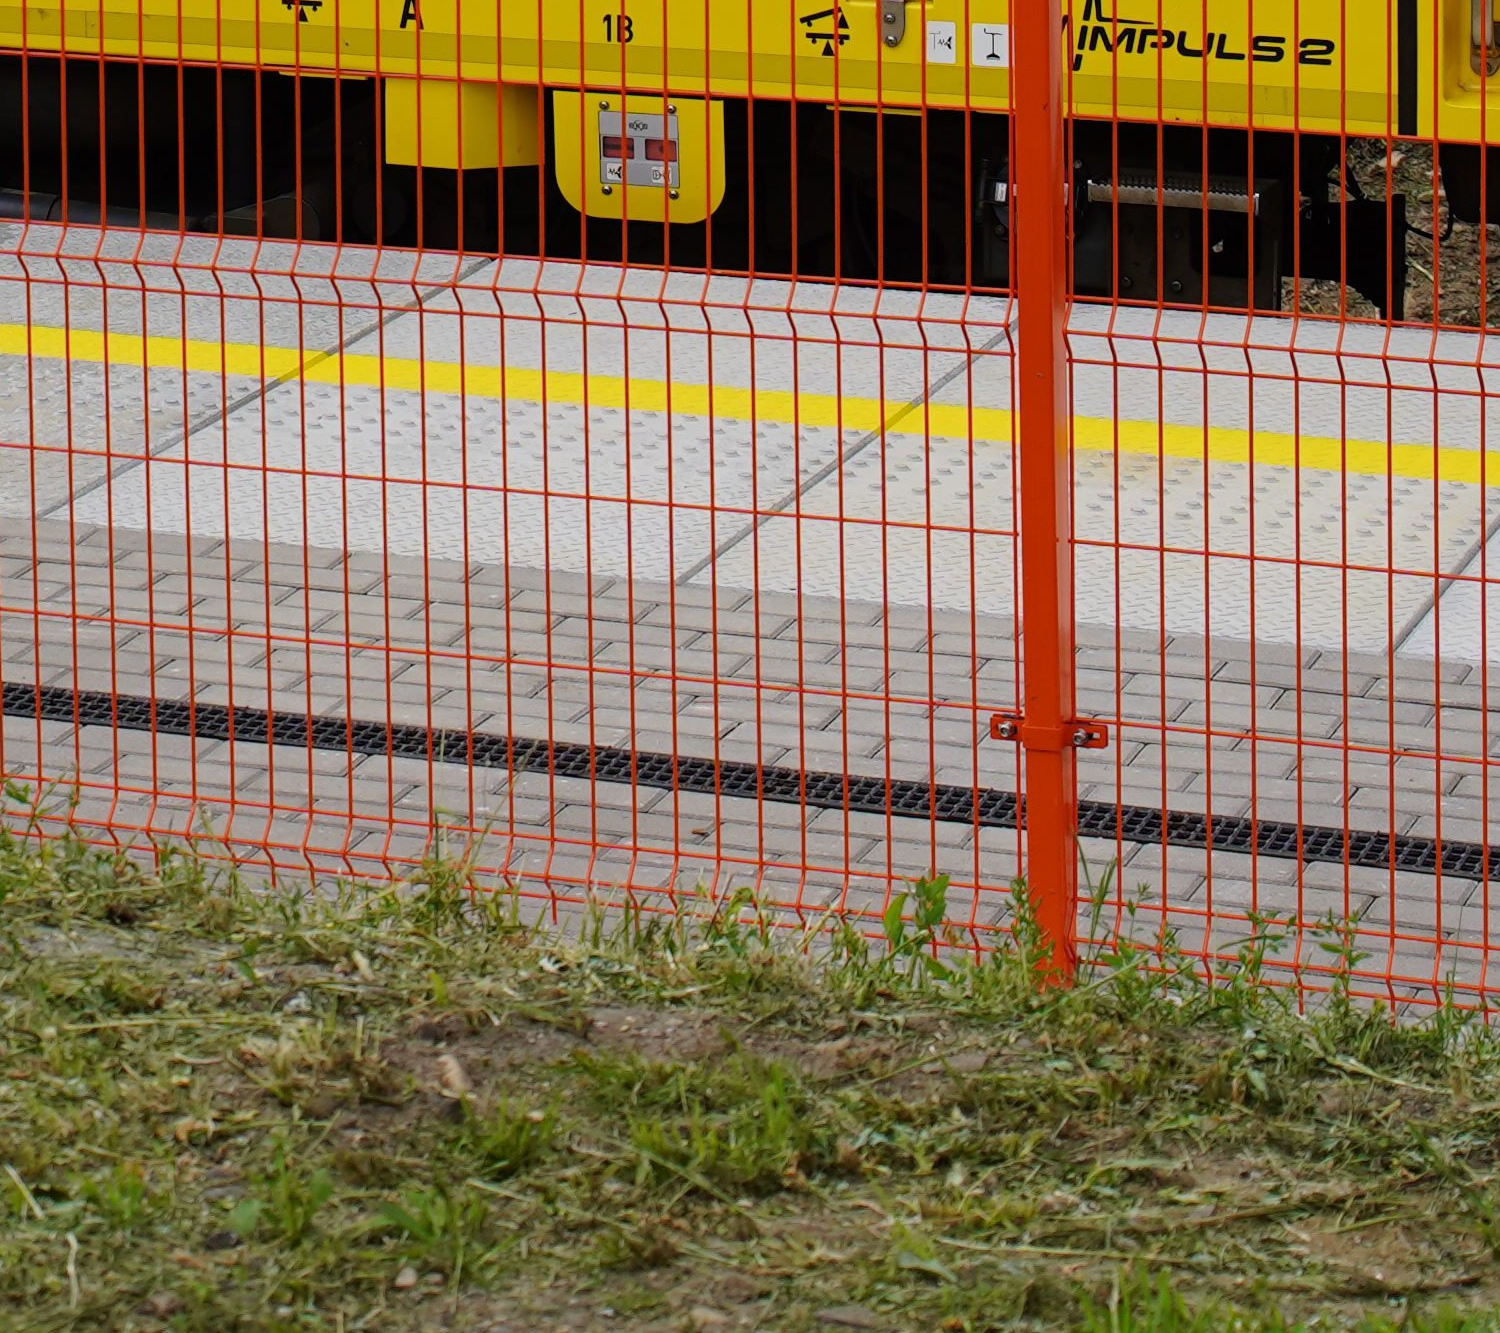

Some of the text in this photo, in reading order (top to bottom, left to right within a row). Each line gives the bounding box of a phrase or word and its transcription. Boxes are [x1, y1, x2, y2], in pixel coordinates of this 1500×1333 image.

[602, 14, 634, 44] 1B
[1077, 24, 1336, 66] IMPULS 2
